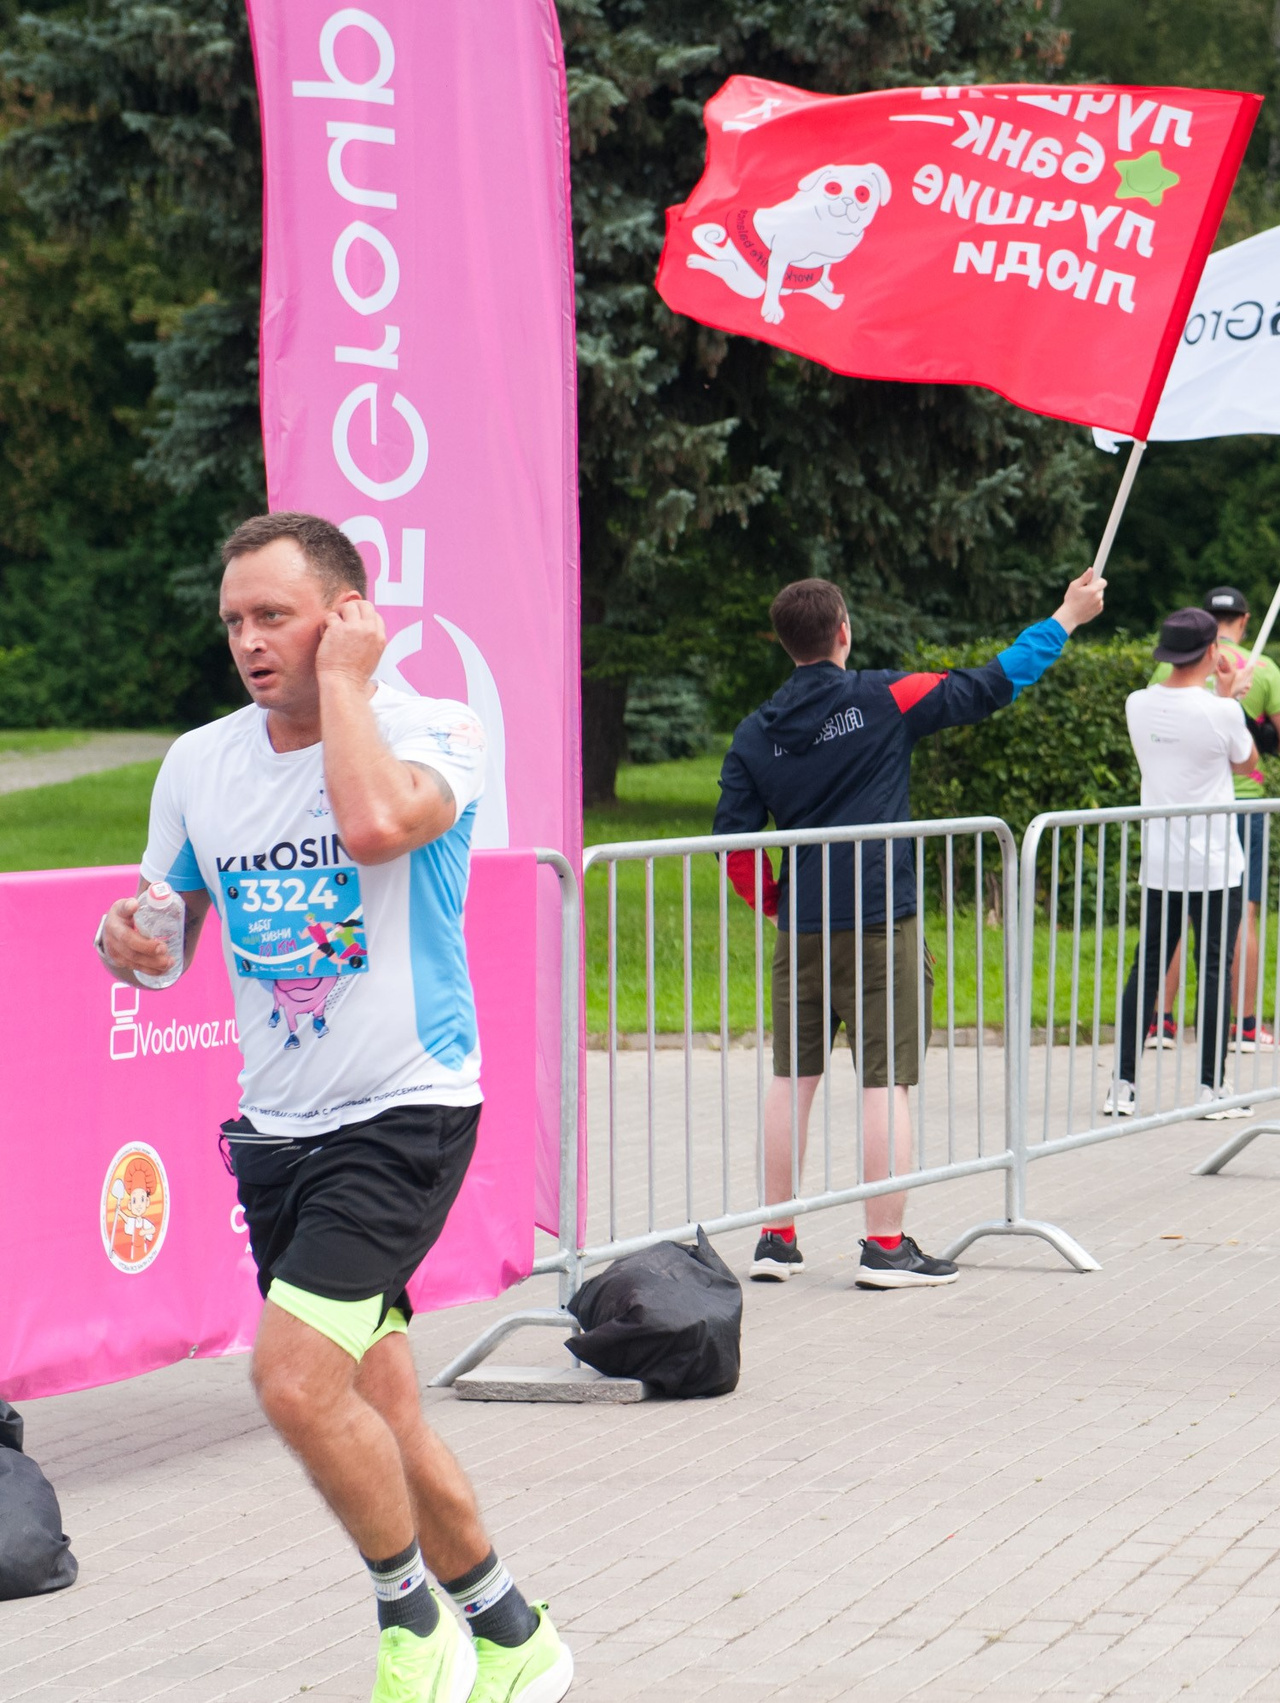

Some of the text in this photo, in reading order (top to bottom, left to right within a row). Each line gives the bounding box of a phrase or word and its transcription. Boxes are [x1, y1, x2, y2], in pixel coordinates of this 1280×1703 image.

[239, 877, 338, 913] 3324
[258, 943, 273, 958] 10
[139, 1018, 241, 1057] Vodovoz.ru
